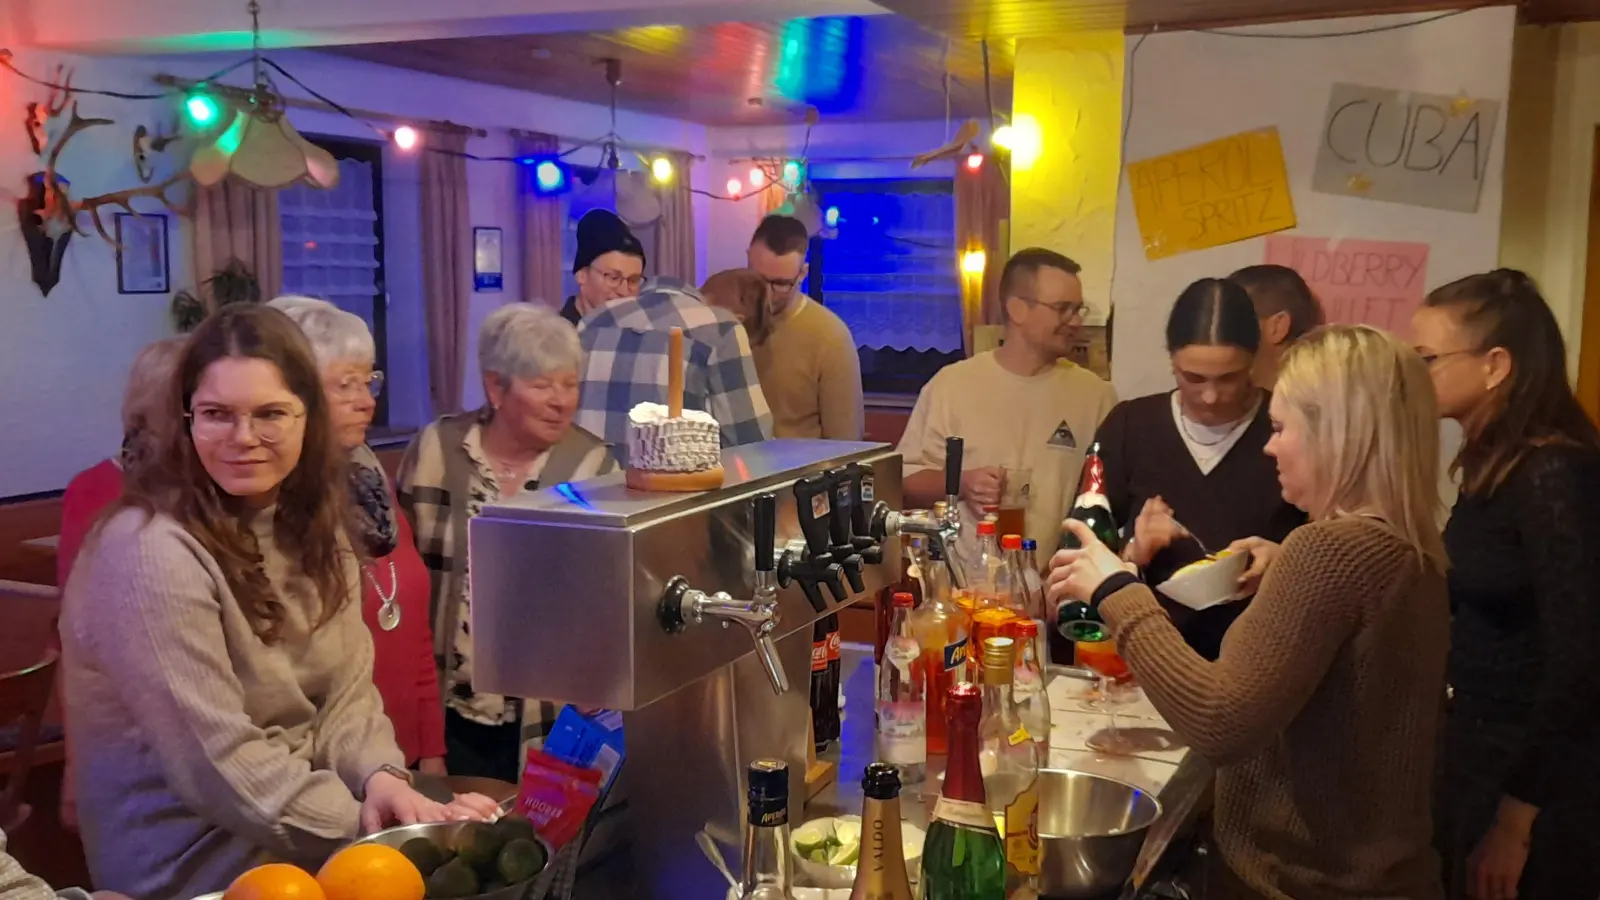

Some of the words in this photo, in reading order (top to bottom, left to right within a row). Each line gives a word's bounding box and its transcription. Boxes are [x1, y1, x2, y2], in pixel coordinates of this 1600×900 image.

[1326, 98, 1480, 181] CUBA
[1135, 137, 1274, 213] APEROL
[1182, 186, 1284, 242] SPRITZ
[1266, 239, 1427, 290] DBERRY
[873, 819, 885, 872] VALDO
